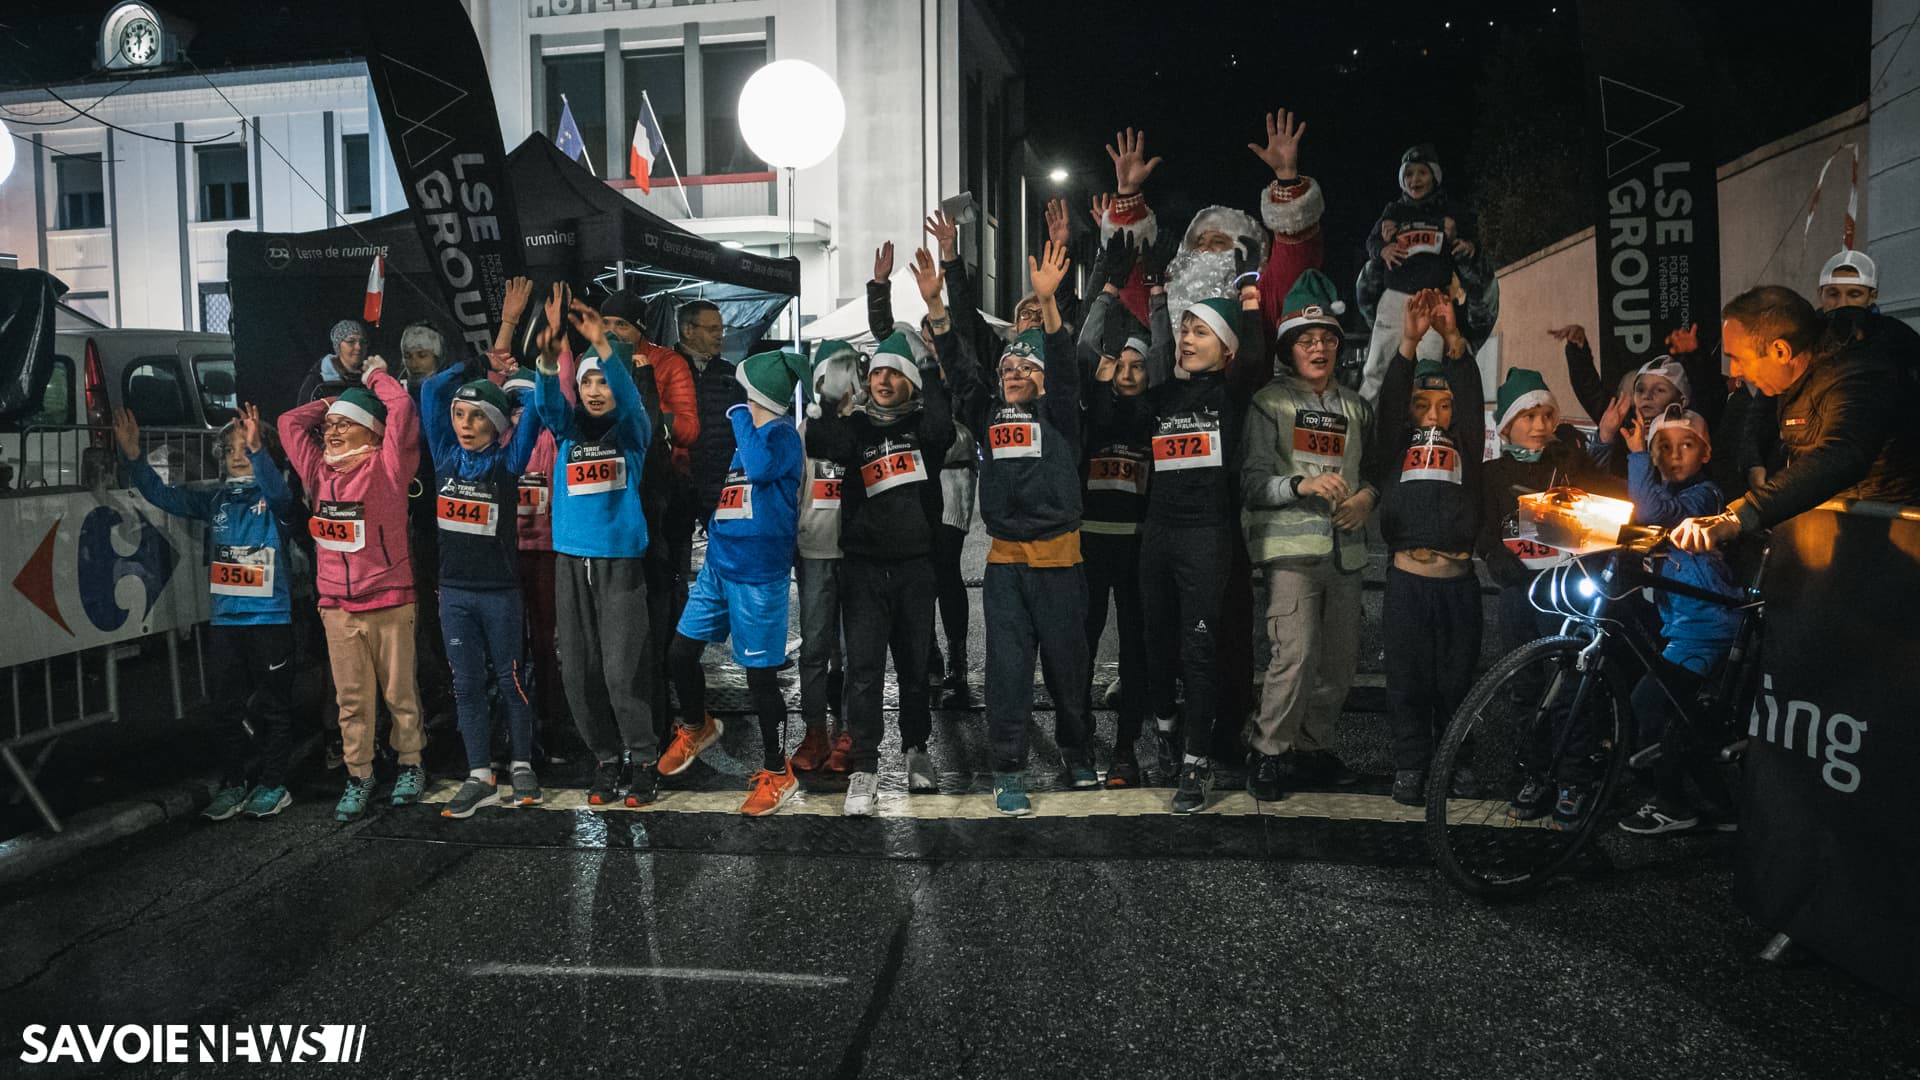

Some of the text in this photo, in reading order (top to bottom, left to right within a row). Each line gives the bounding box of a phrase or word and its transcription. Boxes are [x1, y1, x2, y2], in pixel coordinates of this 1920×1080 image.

[452, 153, 500, 242] LSE
[1653, 161, 1693, 245] LSE
[525, 230, 576, 247] running
[295, 243, 389, 259] terre de running
[1608, 178, 1651, 353] GROUP
[1669, 256, 1679, 307] POUR VOS
[1680, 255, 1690, 331] DES SOLUTION
[995, 427, 1024, 445] 336
[1308, 434, 1341, 453] 338
[1166, 437, 1202, 456] 372
[575, 463, 609, 482] 346
[722, 489, 738, 505] 47
[825, 482, 842, 497] 35
[445, 502, 481, 521] 344
[318, 521, 347, 539] 343
[220, 566, 255, 584] 350
